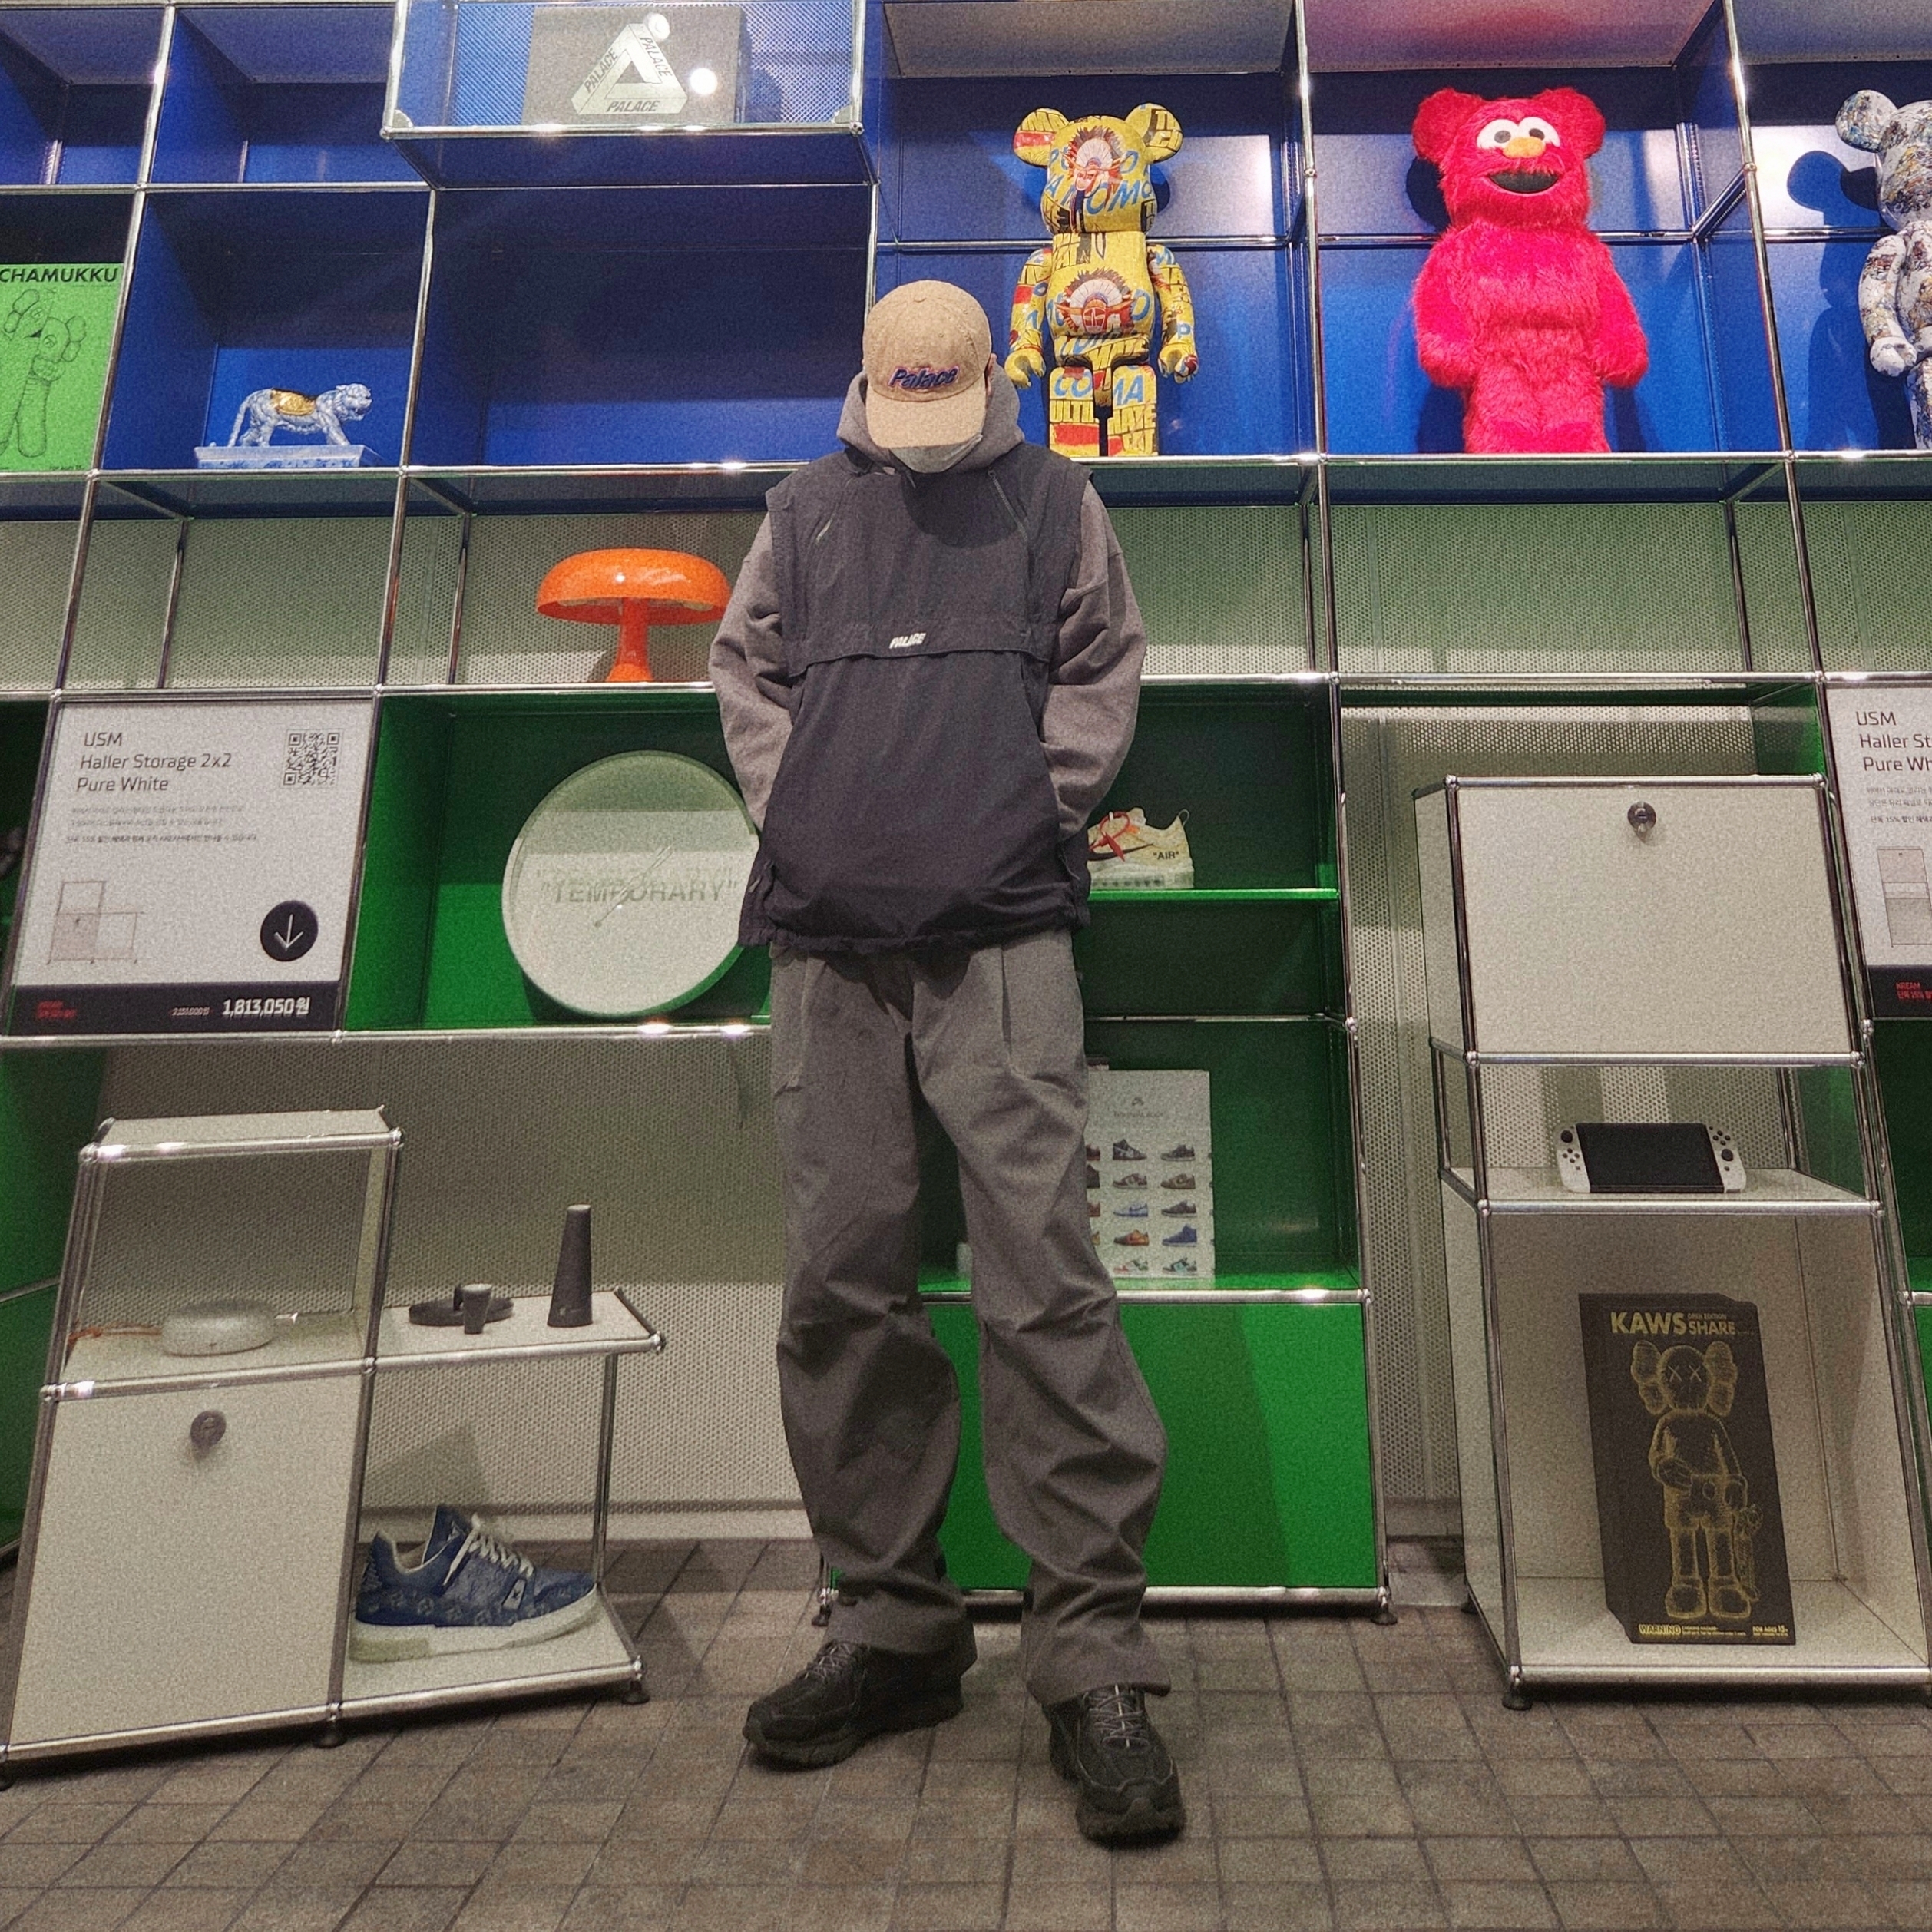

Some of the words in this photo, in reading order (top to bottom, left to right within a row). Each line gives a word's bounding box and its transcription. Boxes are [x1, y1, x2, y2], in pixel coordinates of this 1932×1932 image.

[640, 37, 673, 77] PALACE
[584, 48, 618, 94] PALACE
[606, 100, 660, 113] PALACE
[0, 267, 118, 283] CHAMUKKU
[888, 366, 959, 389] Palace
[888, 632, 927, 649] PALACE
[1855, 711, 1897, 726] USM
[84, 732, 123, 747] USM
[1859, 733, 1909, 748] Haller
[80, 754, 130, 769] Haller
[133, 753, 197, 772] Storage
[200, 753, 232, 768] 2x2
[1863, 756, 1903, 771] Pure
[77, 777, 116, 792] Pure
[121, 776, 169, 792] White
[1153, 851, 1179, 860] "AIR"
[222, 997, 310, 1017] 1,813,050원
[1610, 1311, 1688, 1335] KAWS
[1689, 1320, 1736, 1335] SHARE
[1639, 1623, 1681, 1636] WARNING
